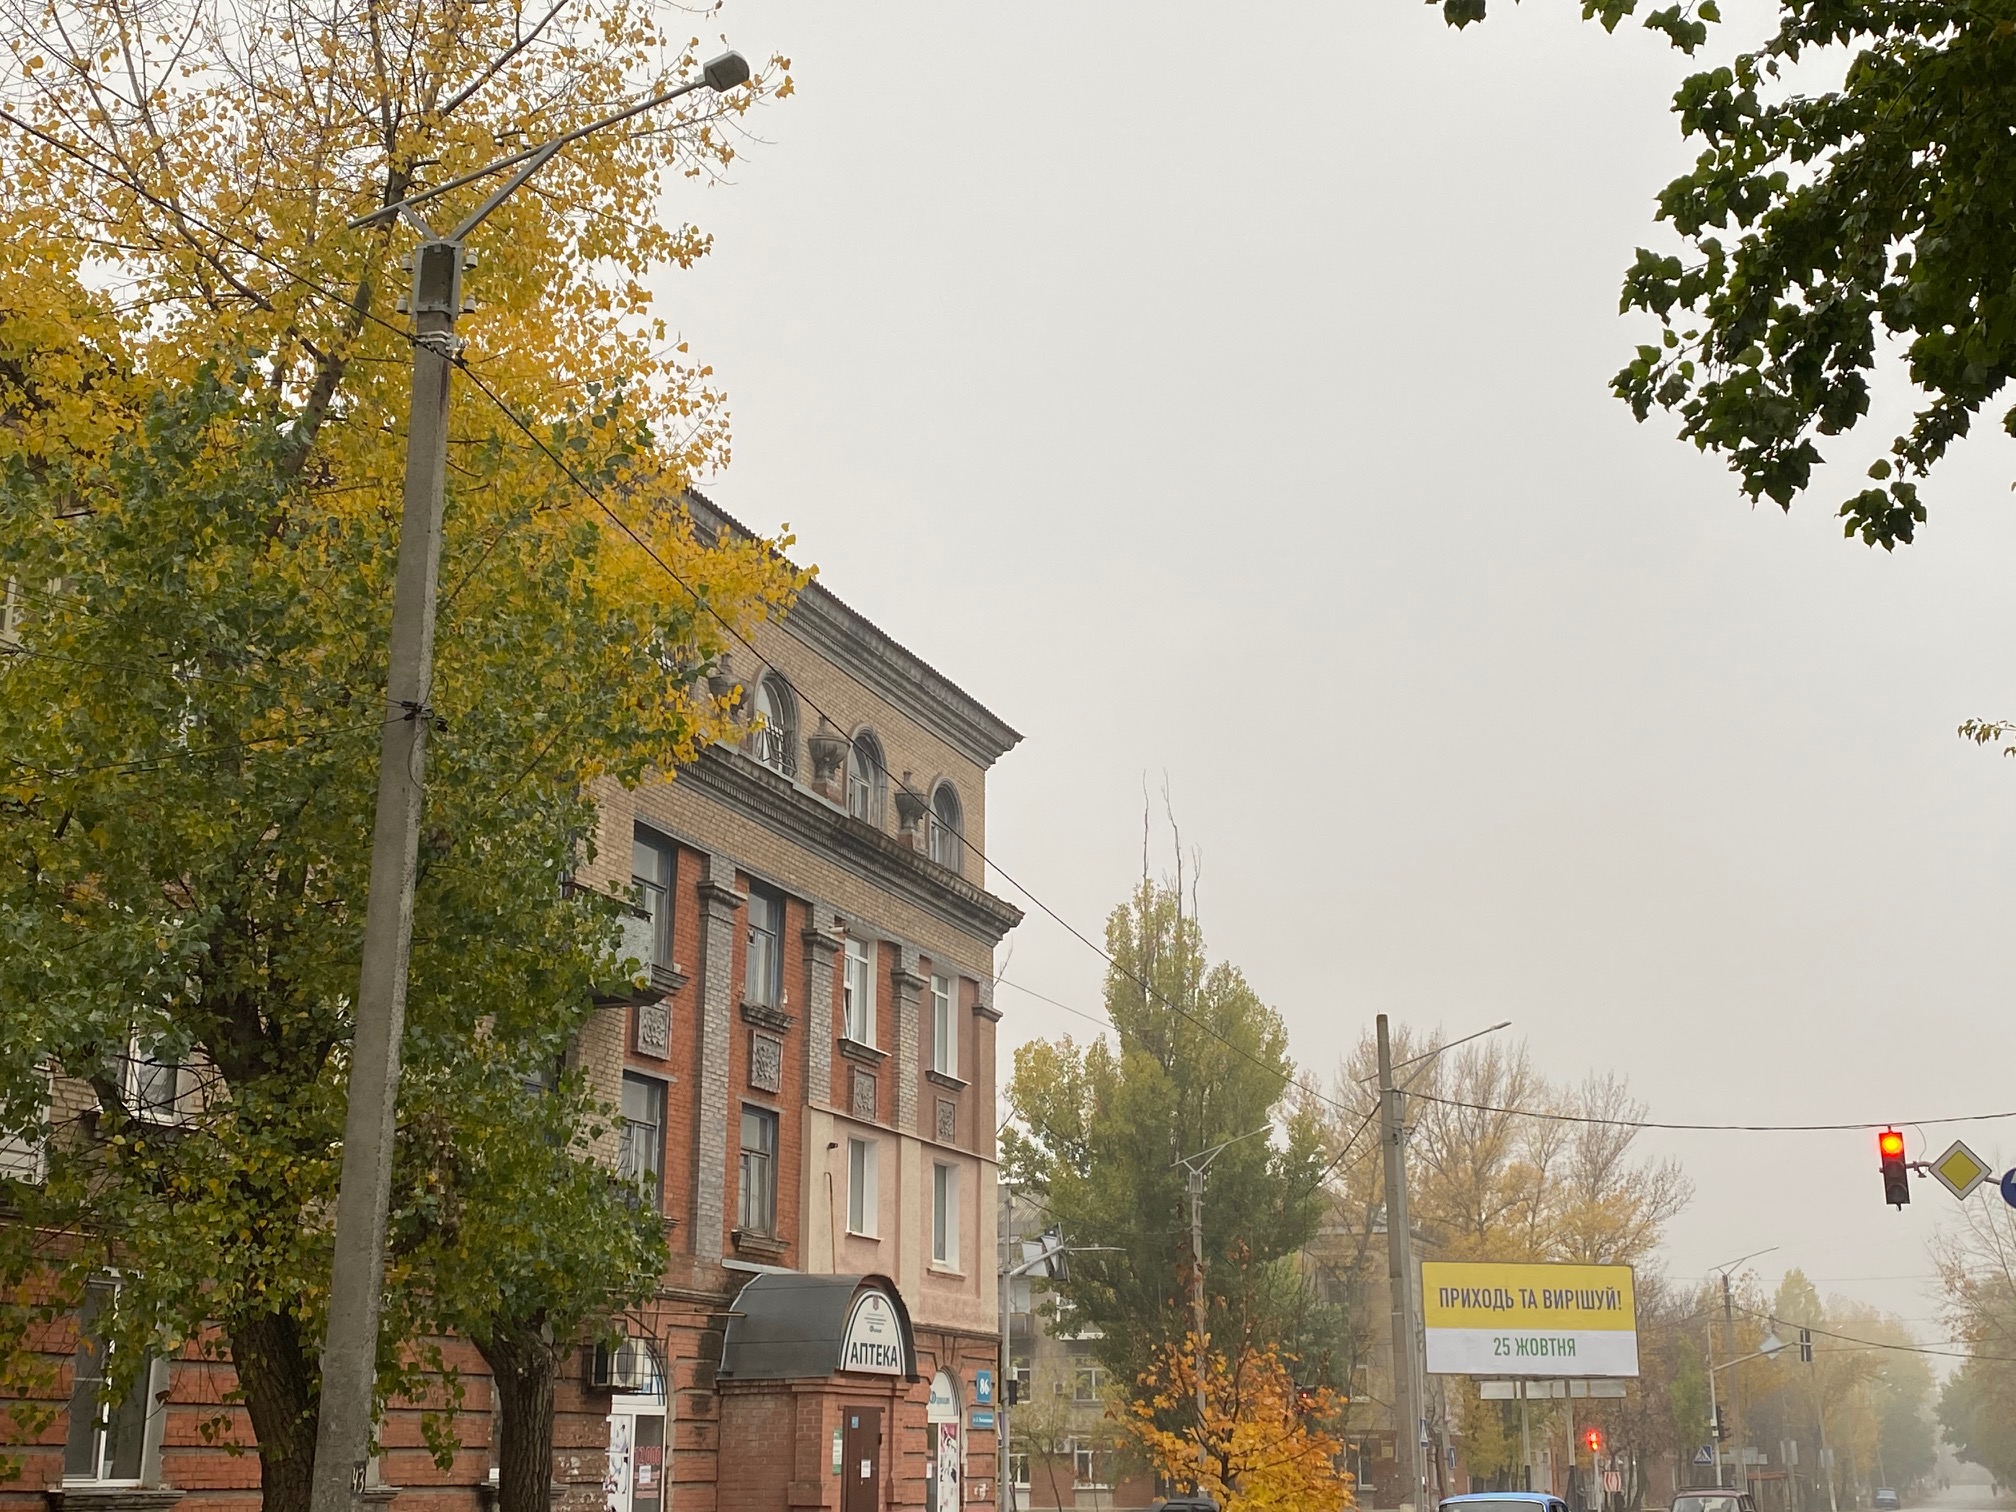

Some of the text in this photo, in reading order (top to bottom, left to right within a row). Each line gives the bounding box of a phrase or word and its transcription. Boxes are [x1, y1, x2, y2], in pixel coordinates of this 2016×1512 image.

[1439, 1286, 1622, 1312] ПРИХОДЬ ТА ВИРІШУЙ!
[850, 1342, 898, 1367] АПТЕКА
[1493, 1337, 1576, 1357] 25 ЖОВТНЯ
